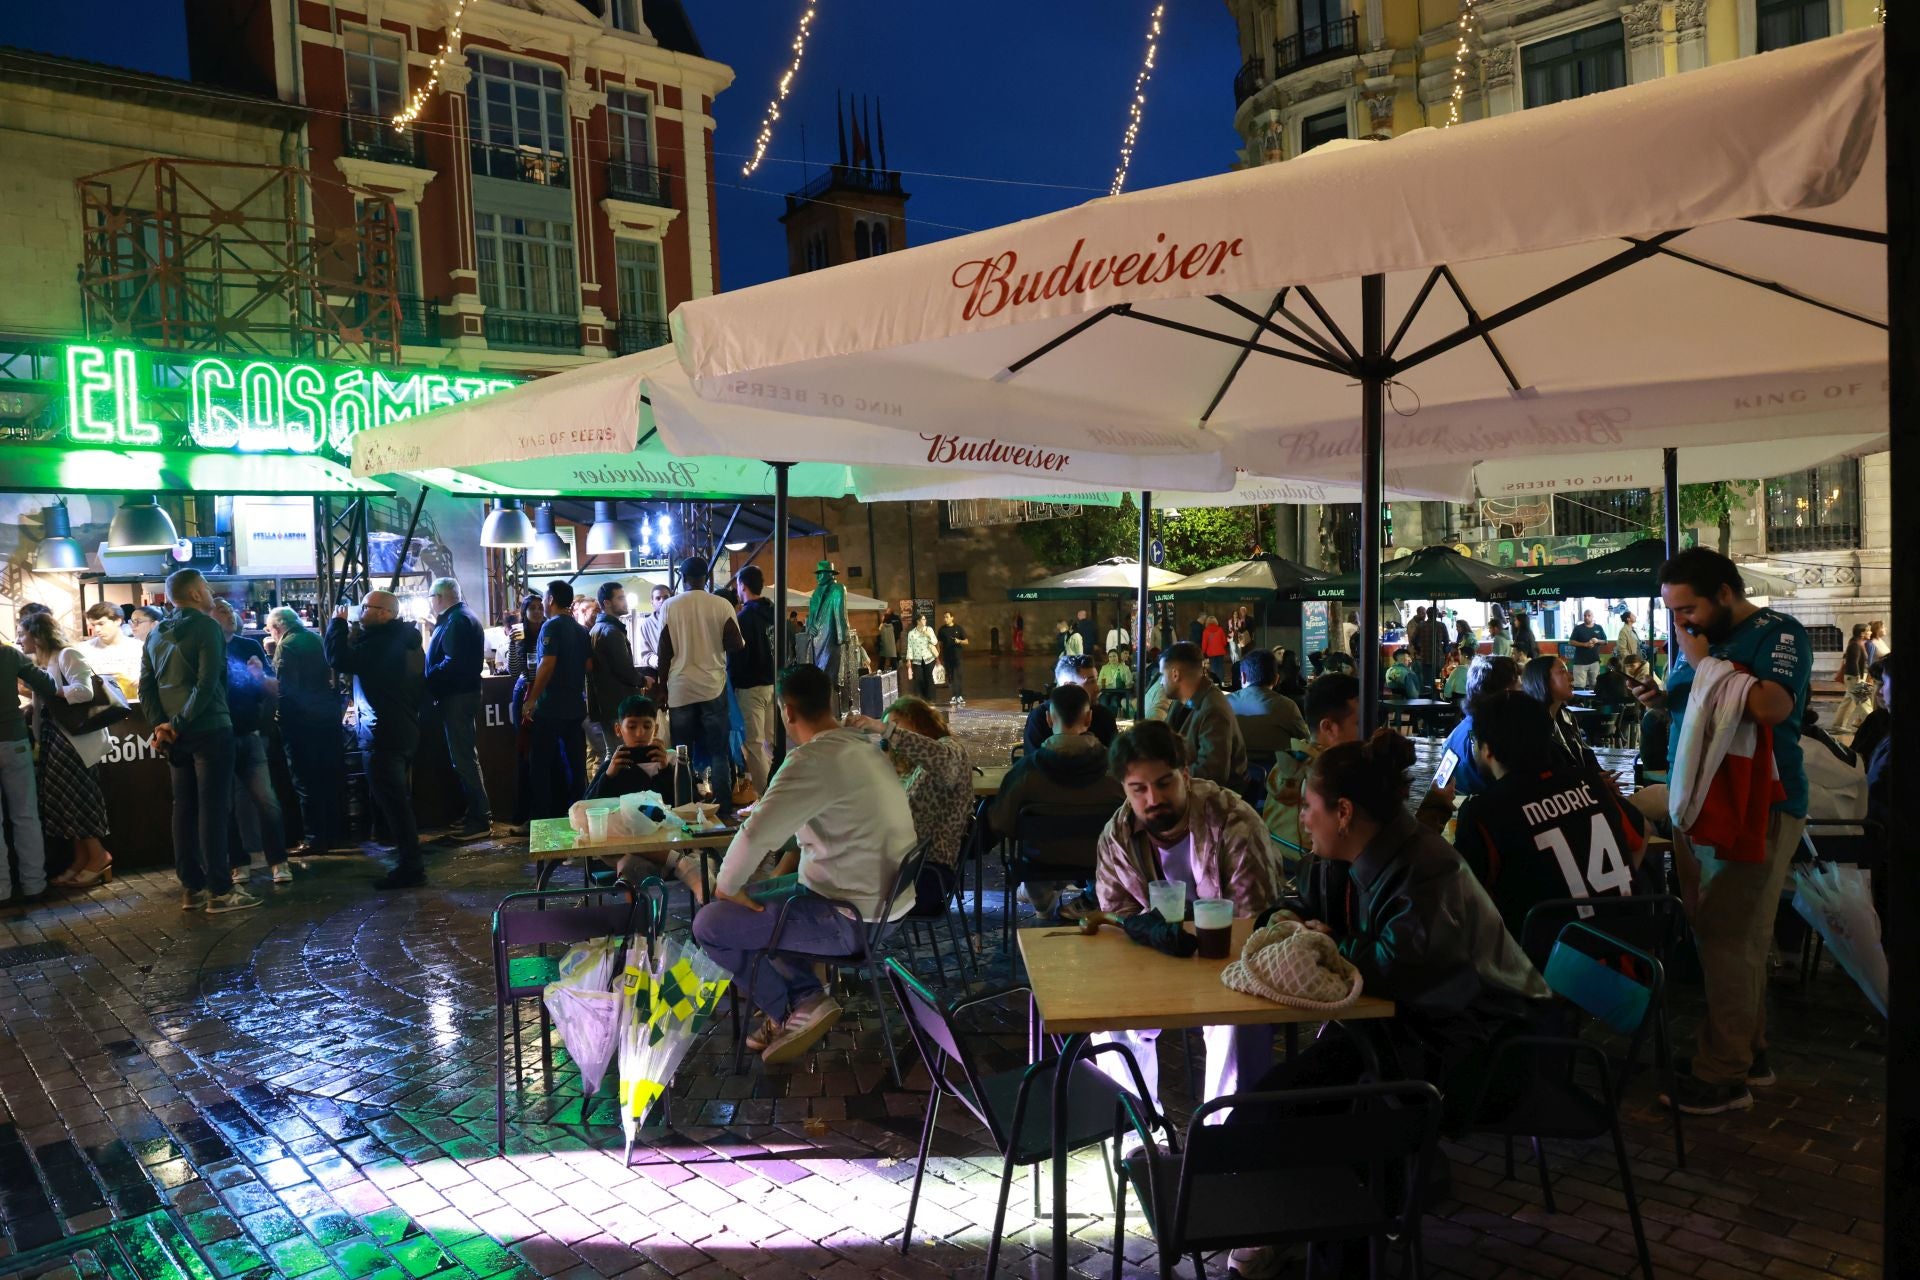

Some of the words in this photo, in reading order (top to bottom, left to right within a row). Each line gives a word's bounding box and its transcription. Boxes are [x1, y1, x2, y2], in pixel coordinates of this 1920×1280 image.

[952, 233, 1243, 320] Budweiser
[66, 345, 160, 443] EL
[1735, 389, 1807, 410] KING
[1824, 383, 1862, 399] OF
[920, 432, 1070, 471] Budweiser
[1537, 587, 1560, 595] SALVE
[1772, 667, 1793, 677] BOSS
[485, 703, 505, 727] EL
[1533, 812, 1633, 919] 14
